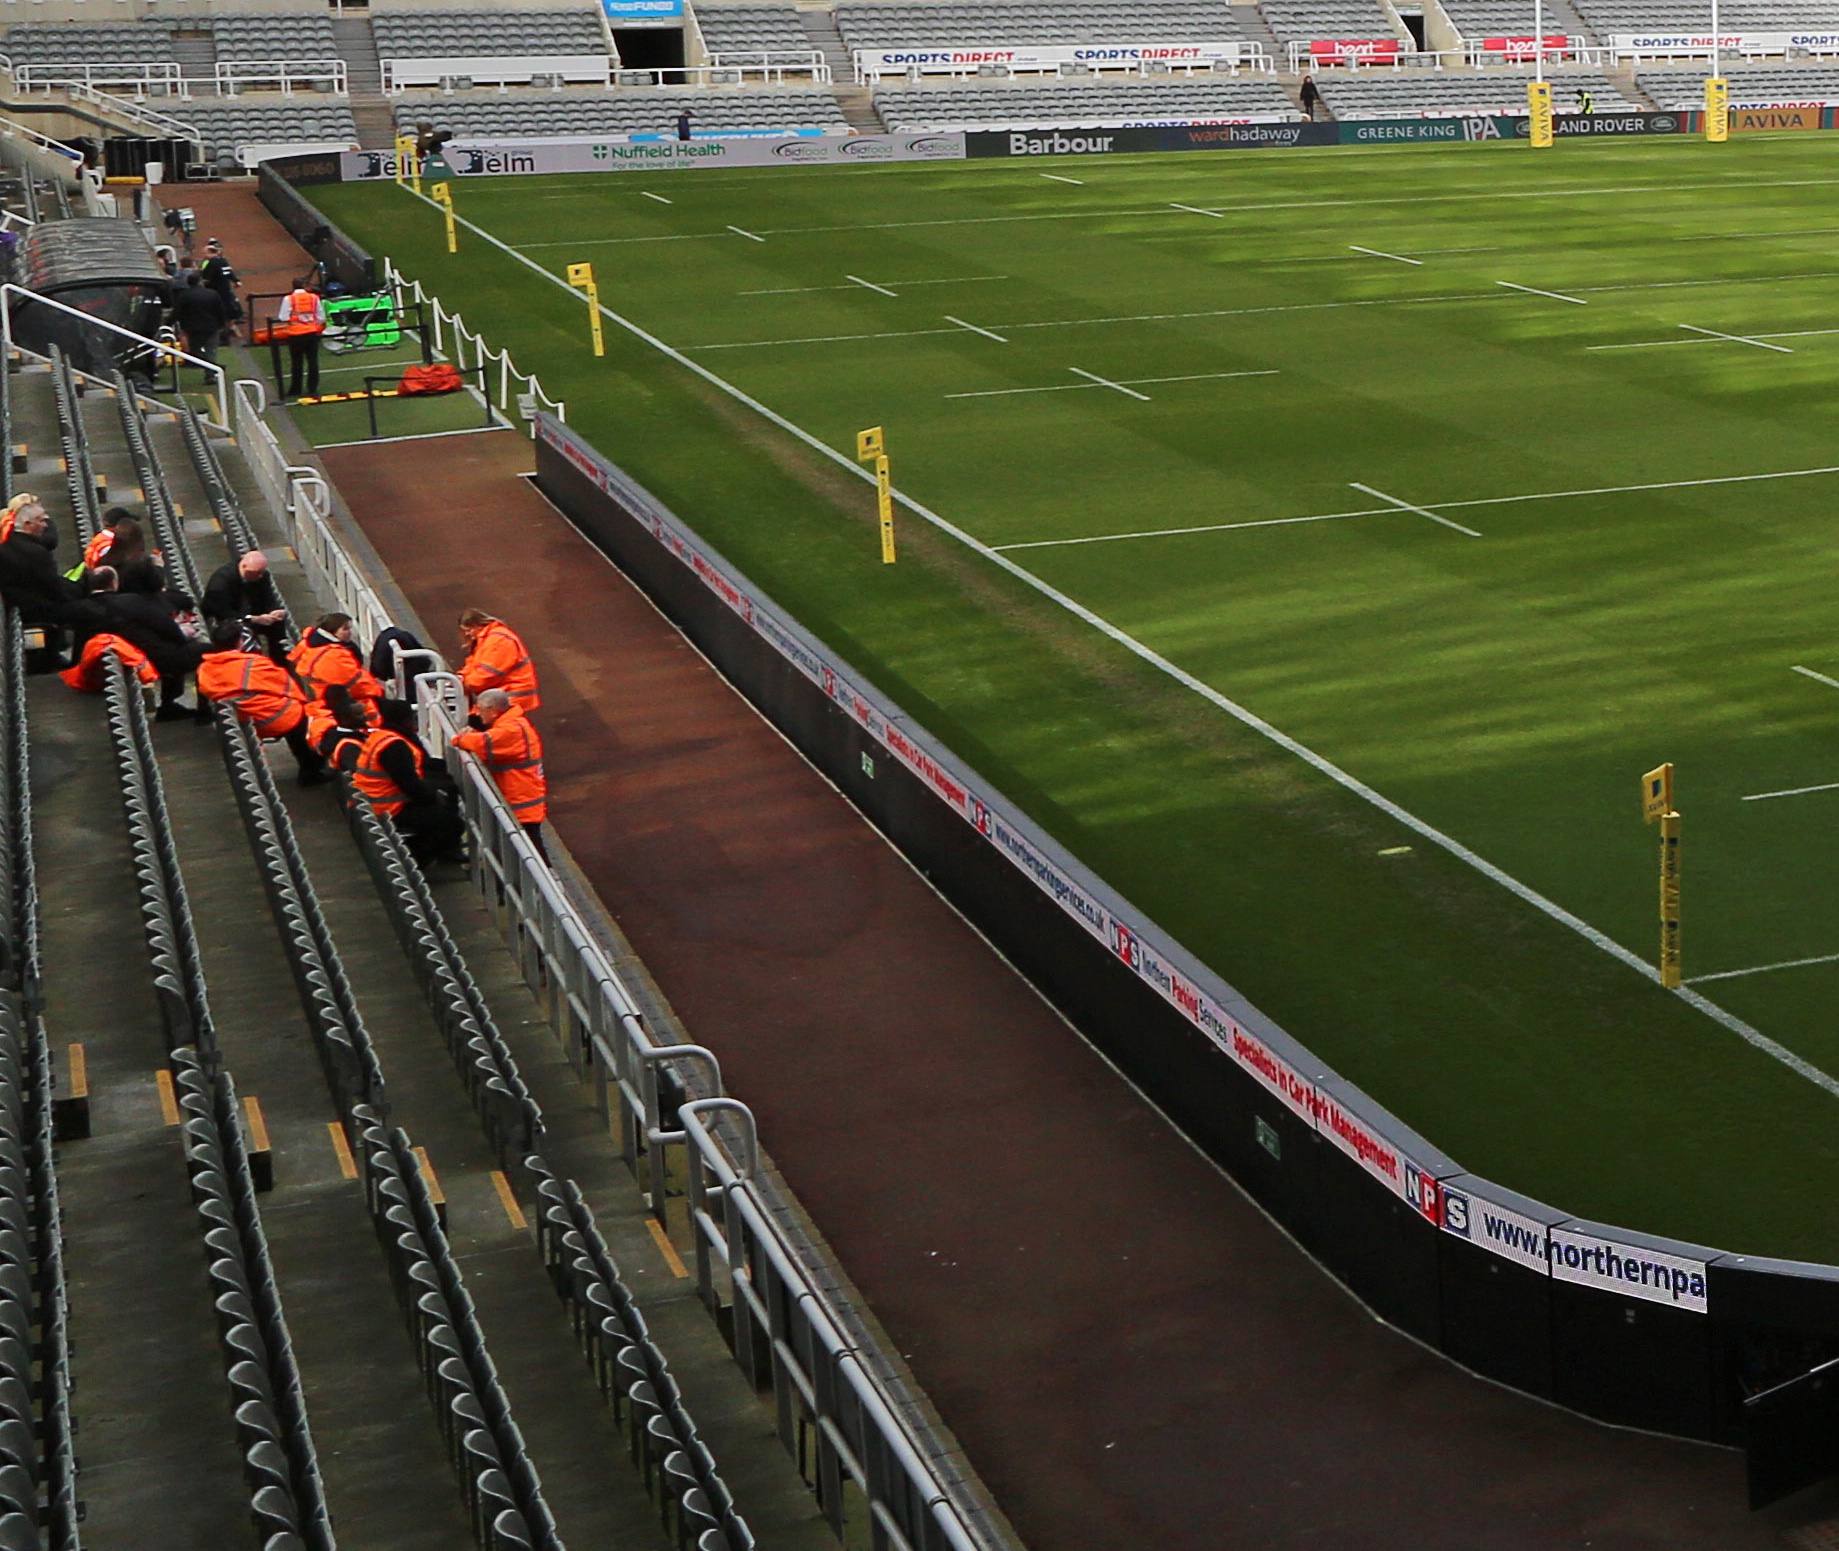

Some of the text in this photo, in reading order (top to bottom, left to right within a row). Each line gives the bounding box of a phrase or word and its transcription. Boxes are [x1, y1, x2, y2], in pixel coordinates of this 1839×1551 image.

[1539, 101, 1549, 140] AVIVA
[1553, 117, 1644, 133] AND ROVER
[1715, 96, 1725, 135] AVIVA
[1743, 114, 1804, 129] AVIVA
[1357, 118, 1501, 141] GREENE KING IPA
[612, 144, 726, 159] Nuffield Health
[1010, 132, 1114, 155] Barbour
[1110, 917, 1139, 970] NPS
[1288, 1072, 1305, 1107] Car
[1331, 1105, 1397, 1181] Management
[1407, 1162, 1468, 1233] NPS
